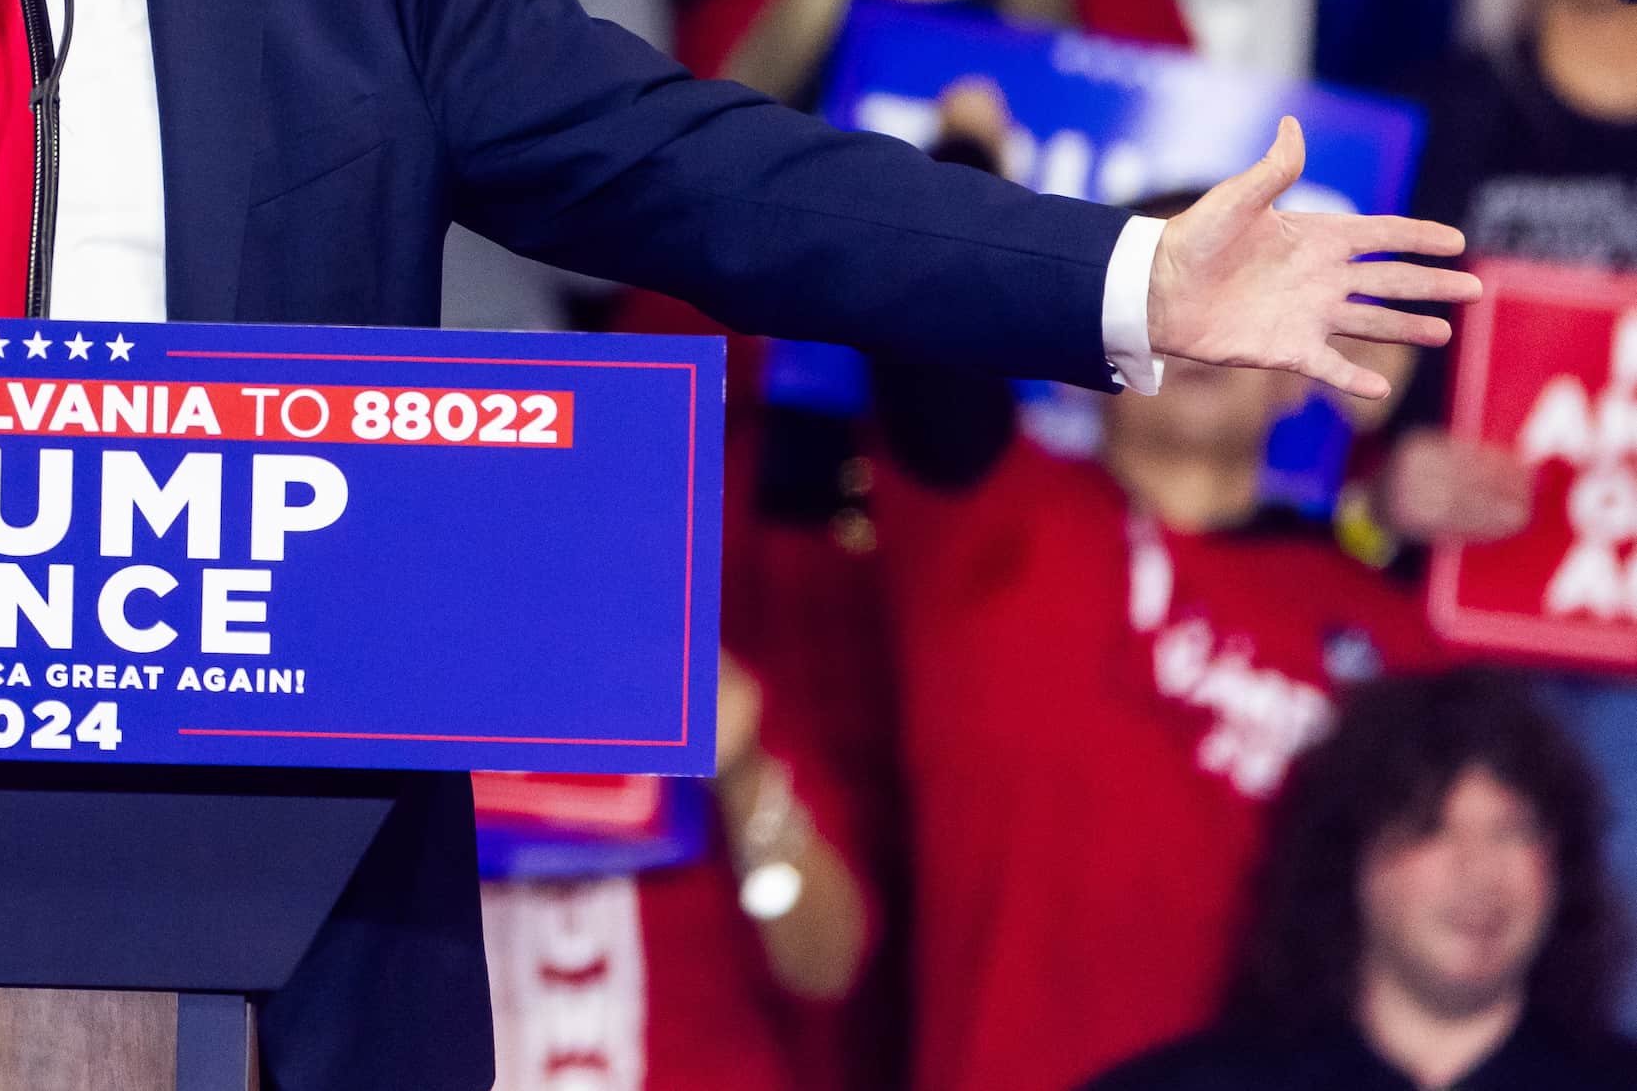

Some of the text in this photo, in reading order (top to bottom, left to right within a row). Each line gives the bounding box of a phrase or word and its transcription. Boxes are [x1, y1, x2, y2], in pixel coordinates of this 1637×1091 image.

[241, 387, 330, 438] TO
[351, 390, 558, 444] 88022
[45, 663, 165, 690] GREAT
[176, 666, 305, 694] AGAIN!
